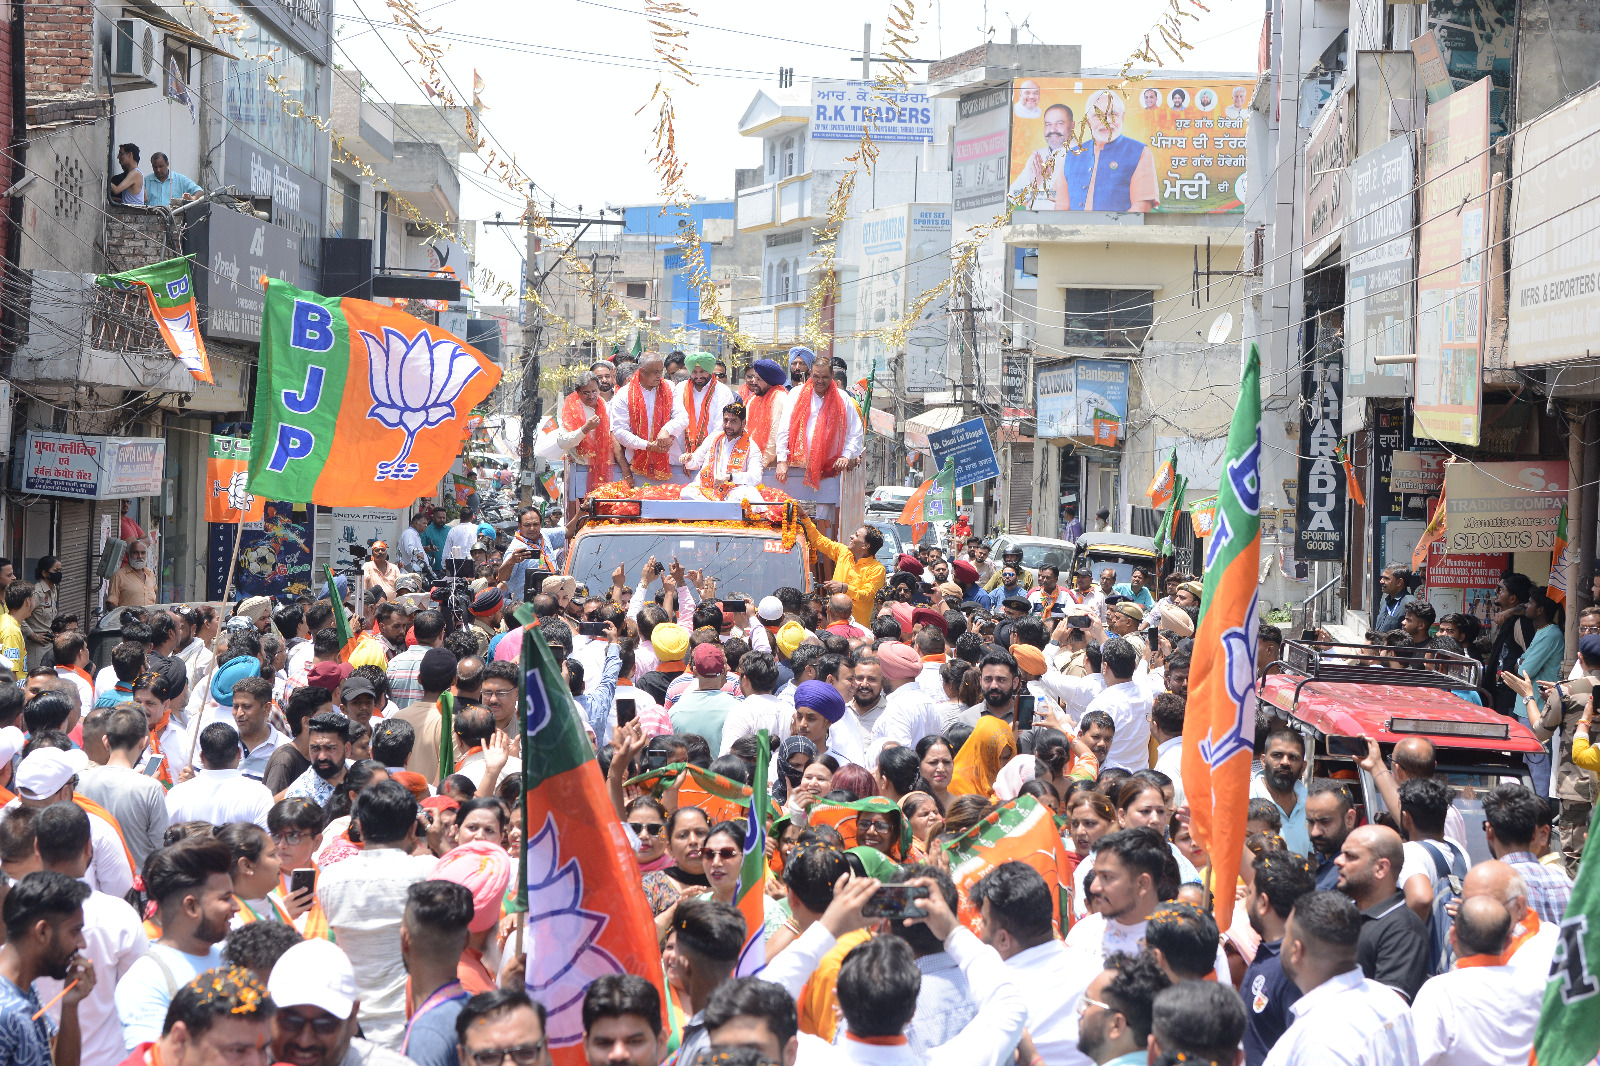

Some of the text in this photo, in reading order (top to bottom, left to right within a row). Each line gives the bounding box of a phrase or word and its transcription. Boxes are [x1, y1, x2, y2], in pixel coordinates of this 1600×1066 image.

[816, 105, 931, 125] R.K TRADERS
[1175, 116, 1244, 130] ਹੁਣ ਗੱਲ ਹੋਵੇਗੀ
[1150, 132, 1188, 149] ਪੰਜਾਬ
[1192, 133, 1209, 149] ਦੀ
[1171, 156, 1188, 168] ਹੁਣ
[1191, 154, 1214, 167] ਗੱਲ
[1163, 170, 1229, 200] ਮੋਦੀ ਦੀ
[913, 218, 940, 226] SPORTS
[920, 211, 946, 220] GET SET
[1520, 276, 1596, 308] MFRS. & EXPORTERS
[212, 308, 240, 333] ANAND
[1450, 498, 1511, 512] TRADING
[362, 513, 398, 521] FITNESS
[1463, 516, 1546, 529] Manufactures
[1301, 530, 1340, 542] SPORTING
[1453, 531, 1533, 550] SPORTS
[764, 541, 791, 554] D.T.
[1306, 540, 1335, 551] GOODS
[1429, 567, 1500, 577] CARROM BOARDS, SPORTS NETS
[1430, 576, 1456, 584] INTERLOCK
[1456, 576, 1469, 584] MATS
[1485, 577, 1500, 585] MATS
